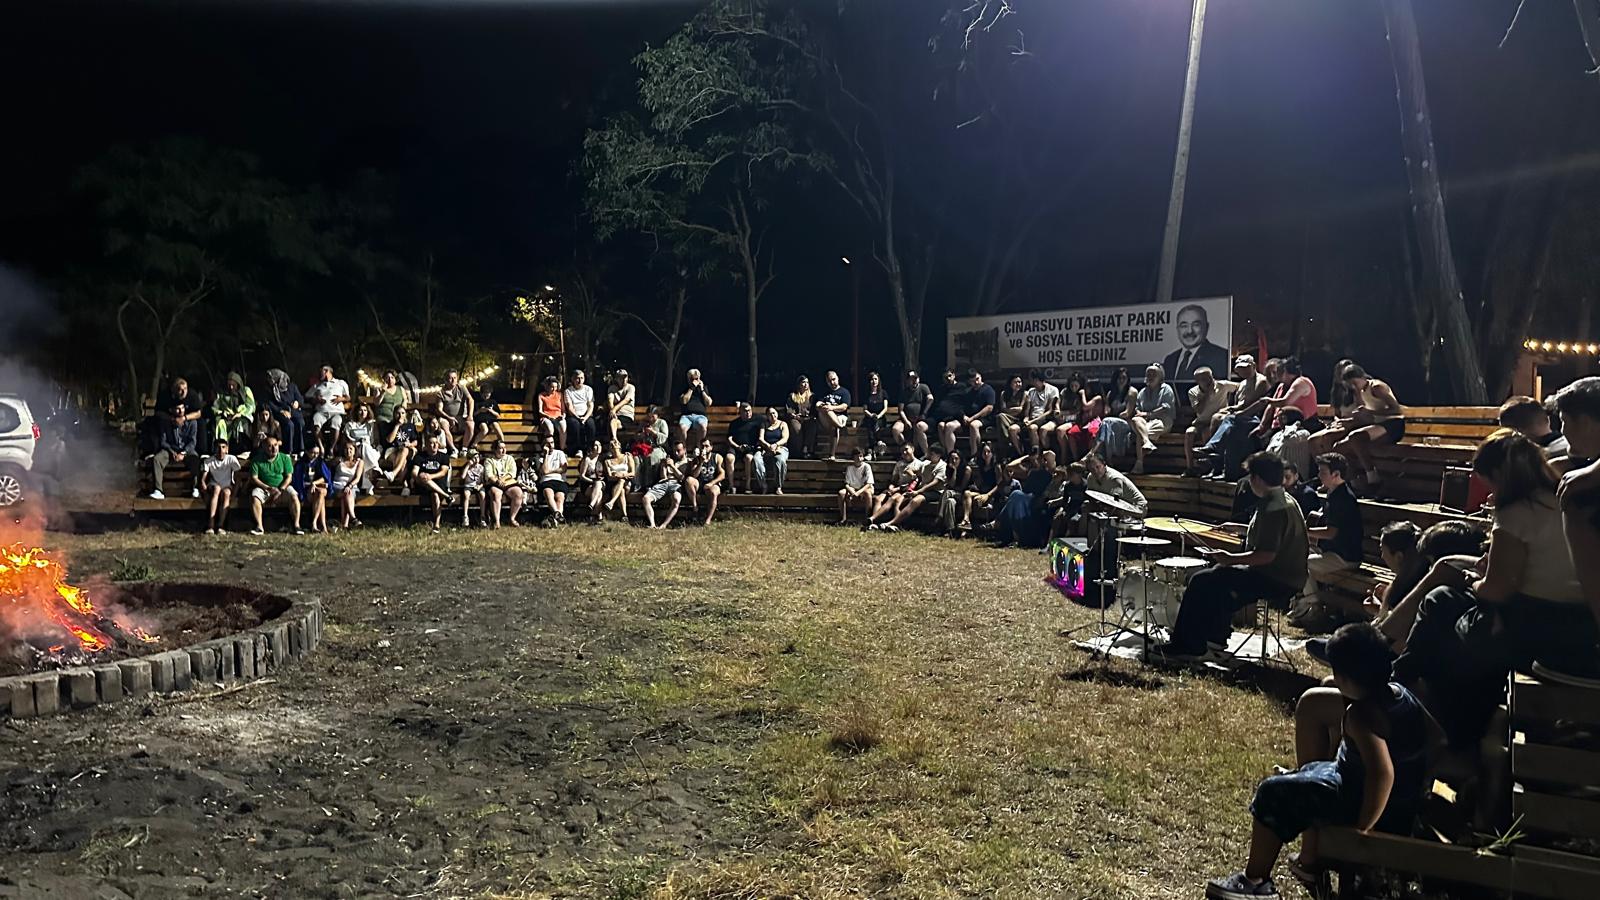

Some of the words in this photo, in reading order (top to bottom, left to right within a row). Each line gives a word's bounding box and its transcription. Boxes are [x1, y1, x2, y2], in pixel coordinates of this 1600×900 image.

[1004, 317, 1073, 337] ÇINARSUYU
[1127, 310, 1171, 326] PARKI
[1009, 338, 1023, 348] ve
[1026, 333, 1073, 348] SOSYAL
[1038, 350, 1063, 366] HOŞ
